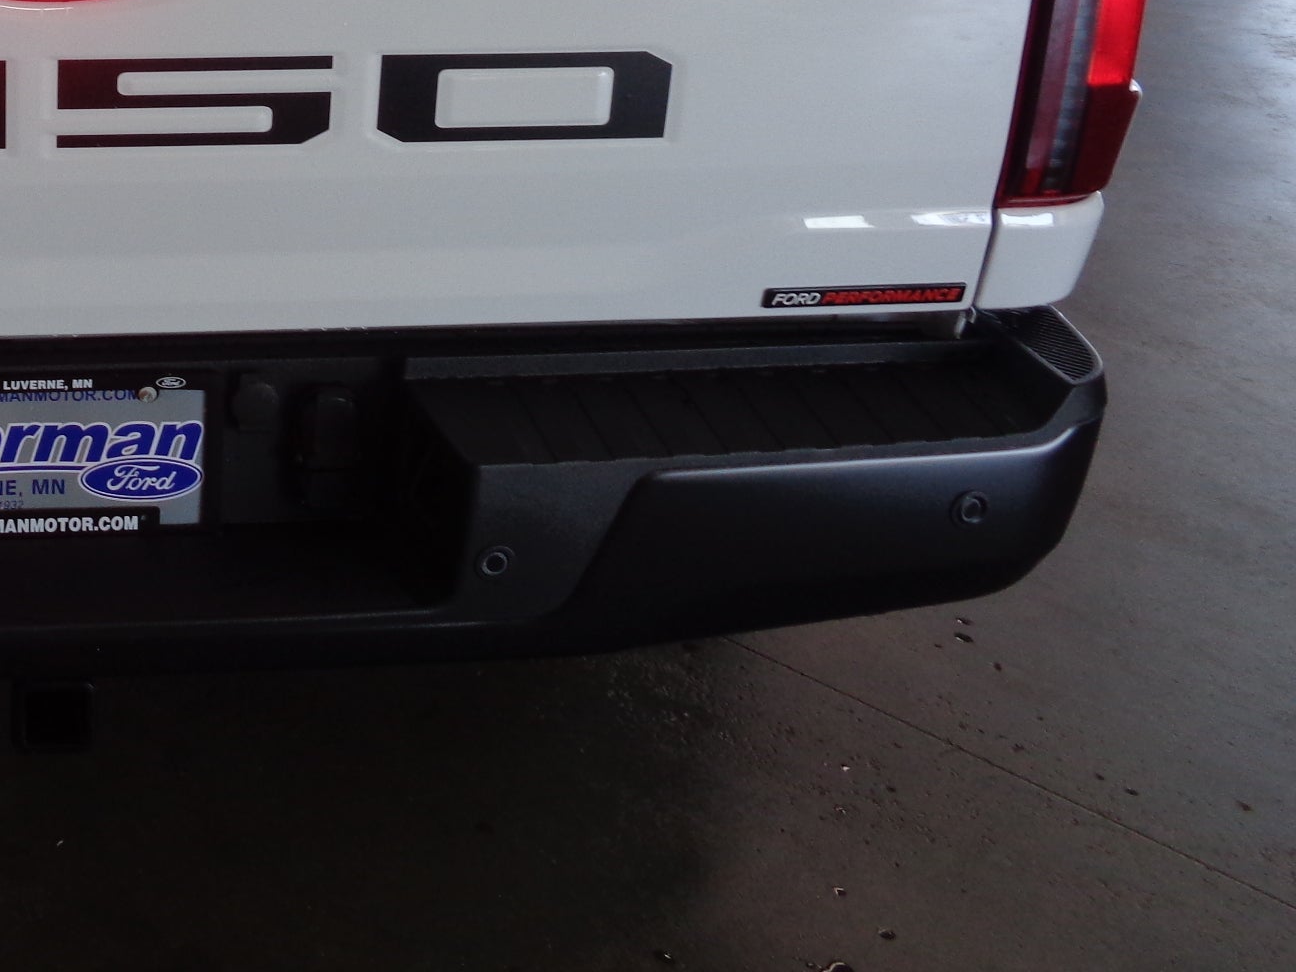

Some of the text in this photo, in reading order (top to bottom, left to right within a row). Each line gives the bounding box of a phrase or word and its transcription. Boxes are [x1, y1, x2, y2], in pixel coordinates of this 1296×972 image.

[771, 288, 961, 306] FORD PERFORMANCE
[3, 378, 93, 391] LUVERNE, MN
[106, 464, 176, 491] Ford
[31, 479, 65, 495] MN
